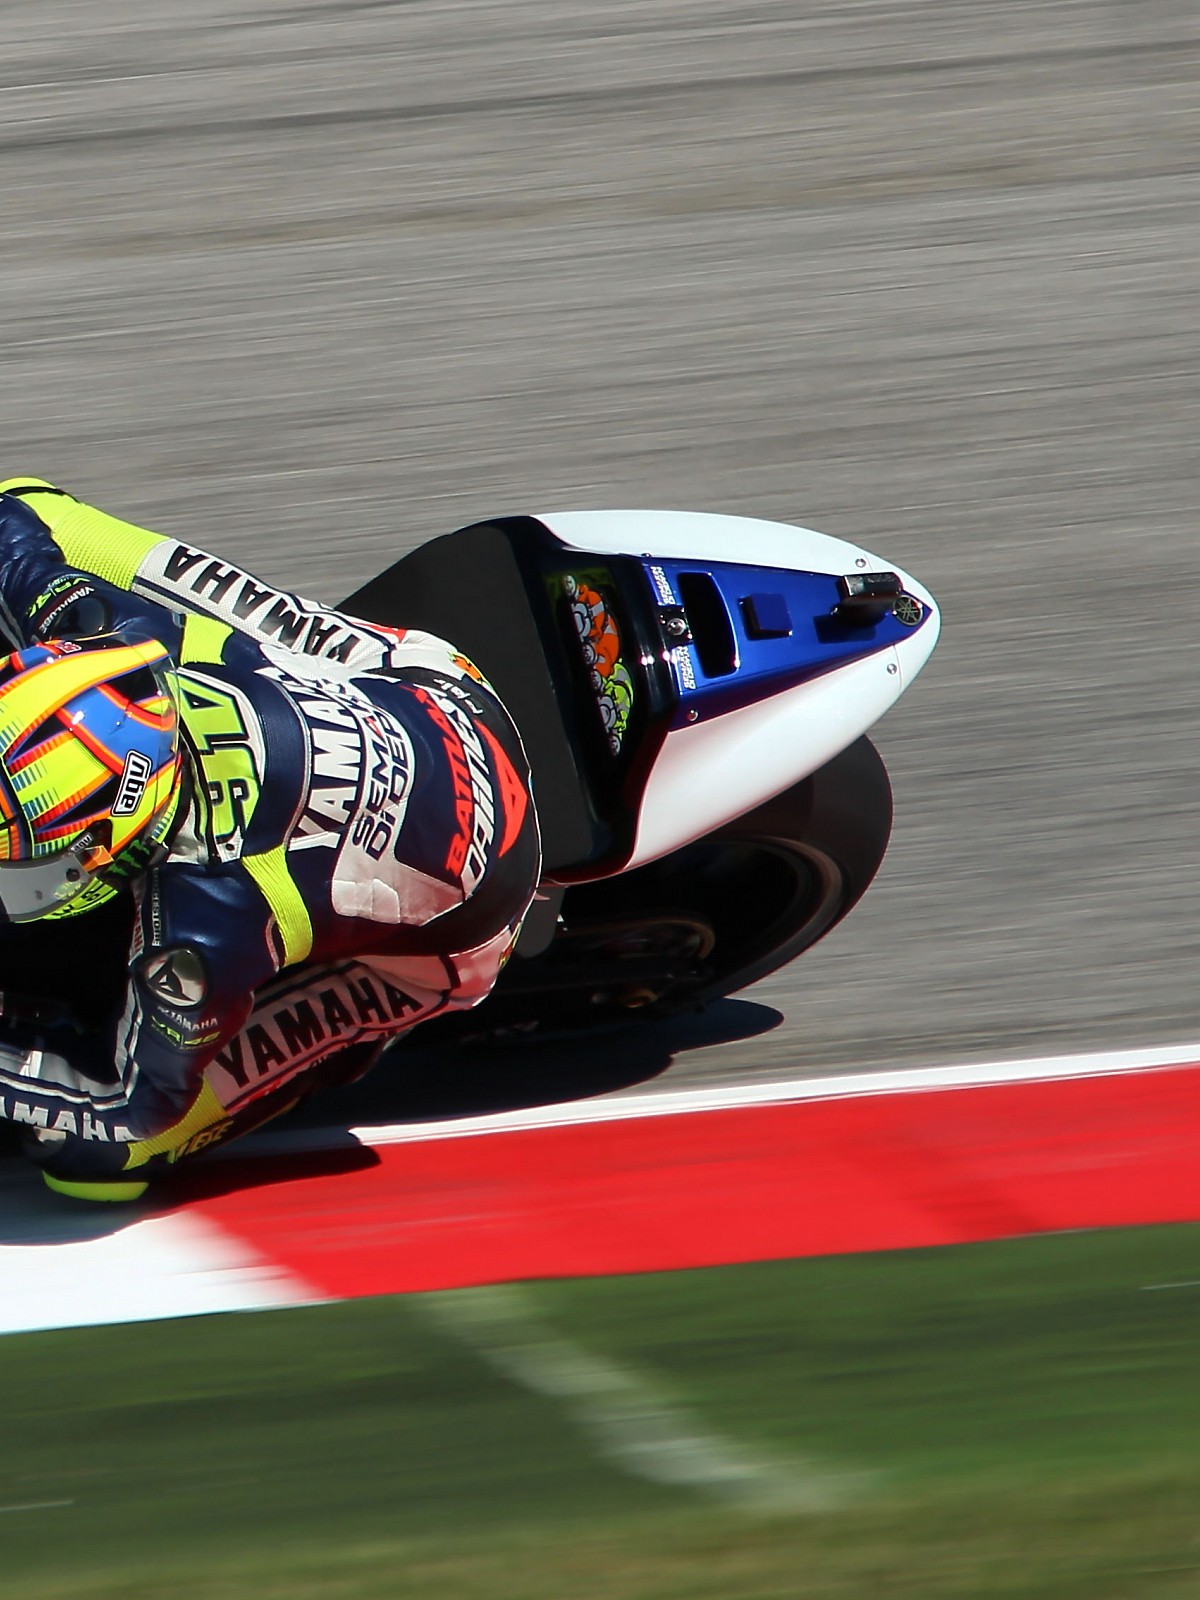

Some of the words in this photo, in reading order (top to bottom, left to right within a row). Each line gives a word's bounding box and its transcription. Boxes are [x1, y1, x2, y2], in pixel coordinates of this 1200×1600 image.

[164, 545, 360, 664] YAMAHA
[121, 757, 146, 812] agv
[214, 976, 423, 1089] YAMAHA
